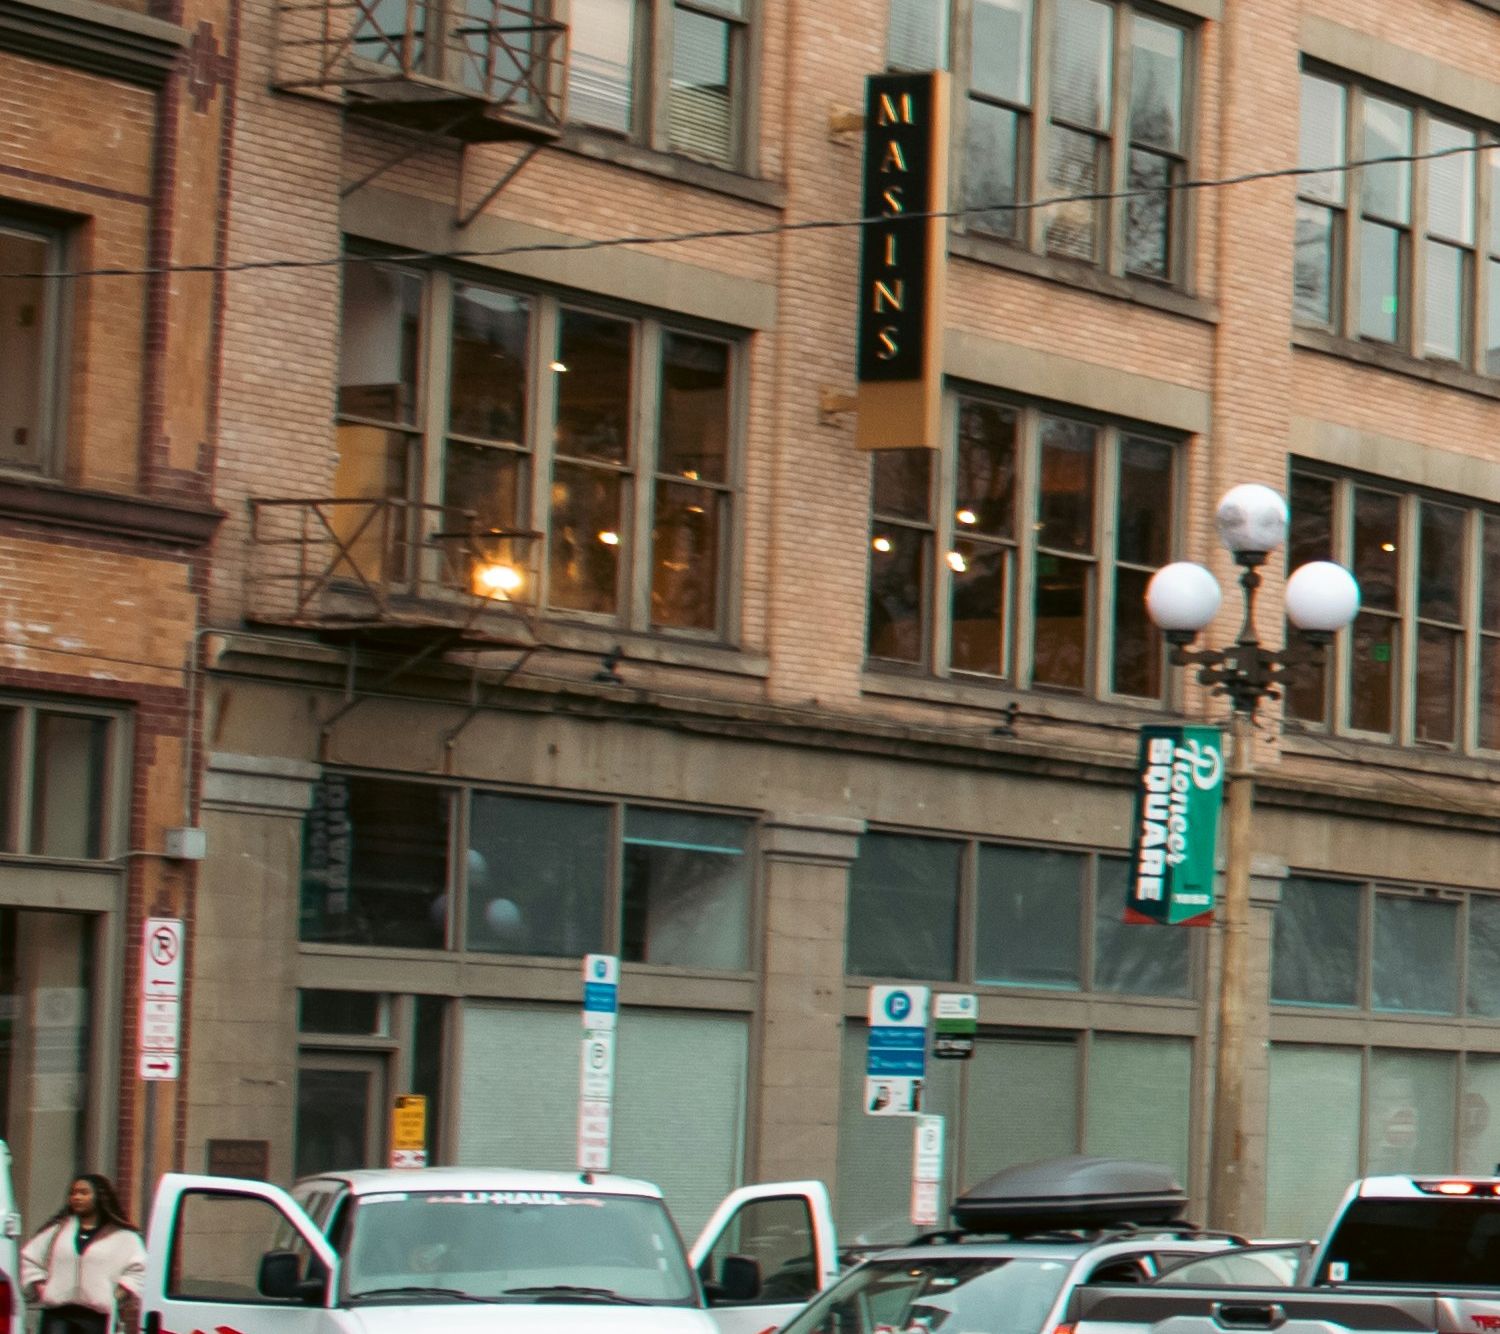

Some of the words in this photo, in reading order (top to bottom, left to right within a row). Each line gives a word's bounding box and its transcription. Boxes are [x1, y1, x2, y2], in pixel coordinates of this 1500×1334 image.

[872, 92, 914, 359] MASINS
[1135, 738, 1176, 902] SQUARE
[1165, 738, 1223, 868] Pioneer
